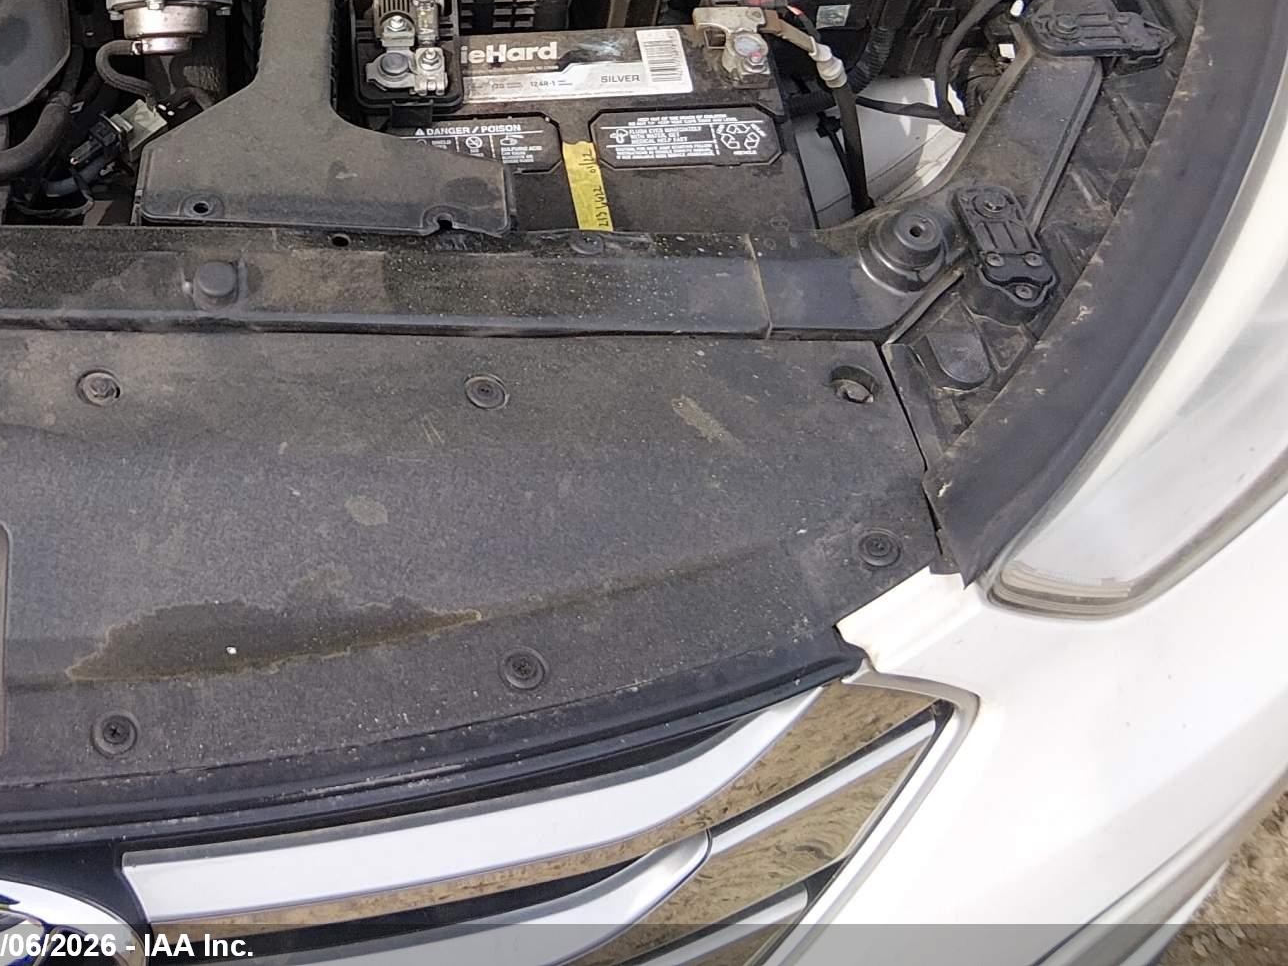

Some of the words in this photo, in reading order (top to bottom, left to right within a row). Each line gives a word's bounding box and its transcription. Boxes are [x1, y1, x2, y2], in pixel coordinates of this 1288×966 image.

[461, 42, 559, 65] ieHard
[600, 74, 641, 84] SILVER
[426, 126, 470, 136] DANGER
[481, 124, 522, 133] POISON
